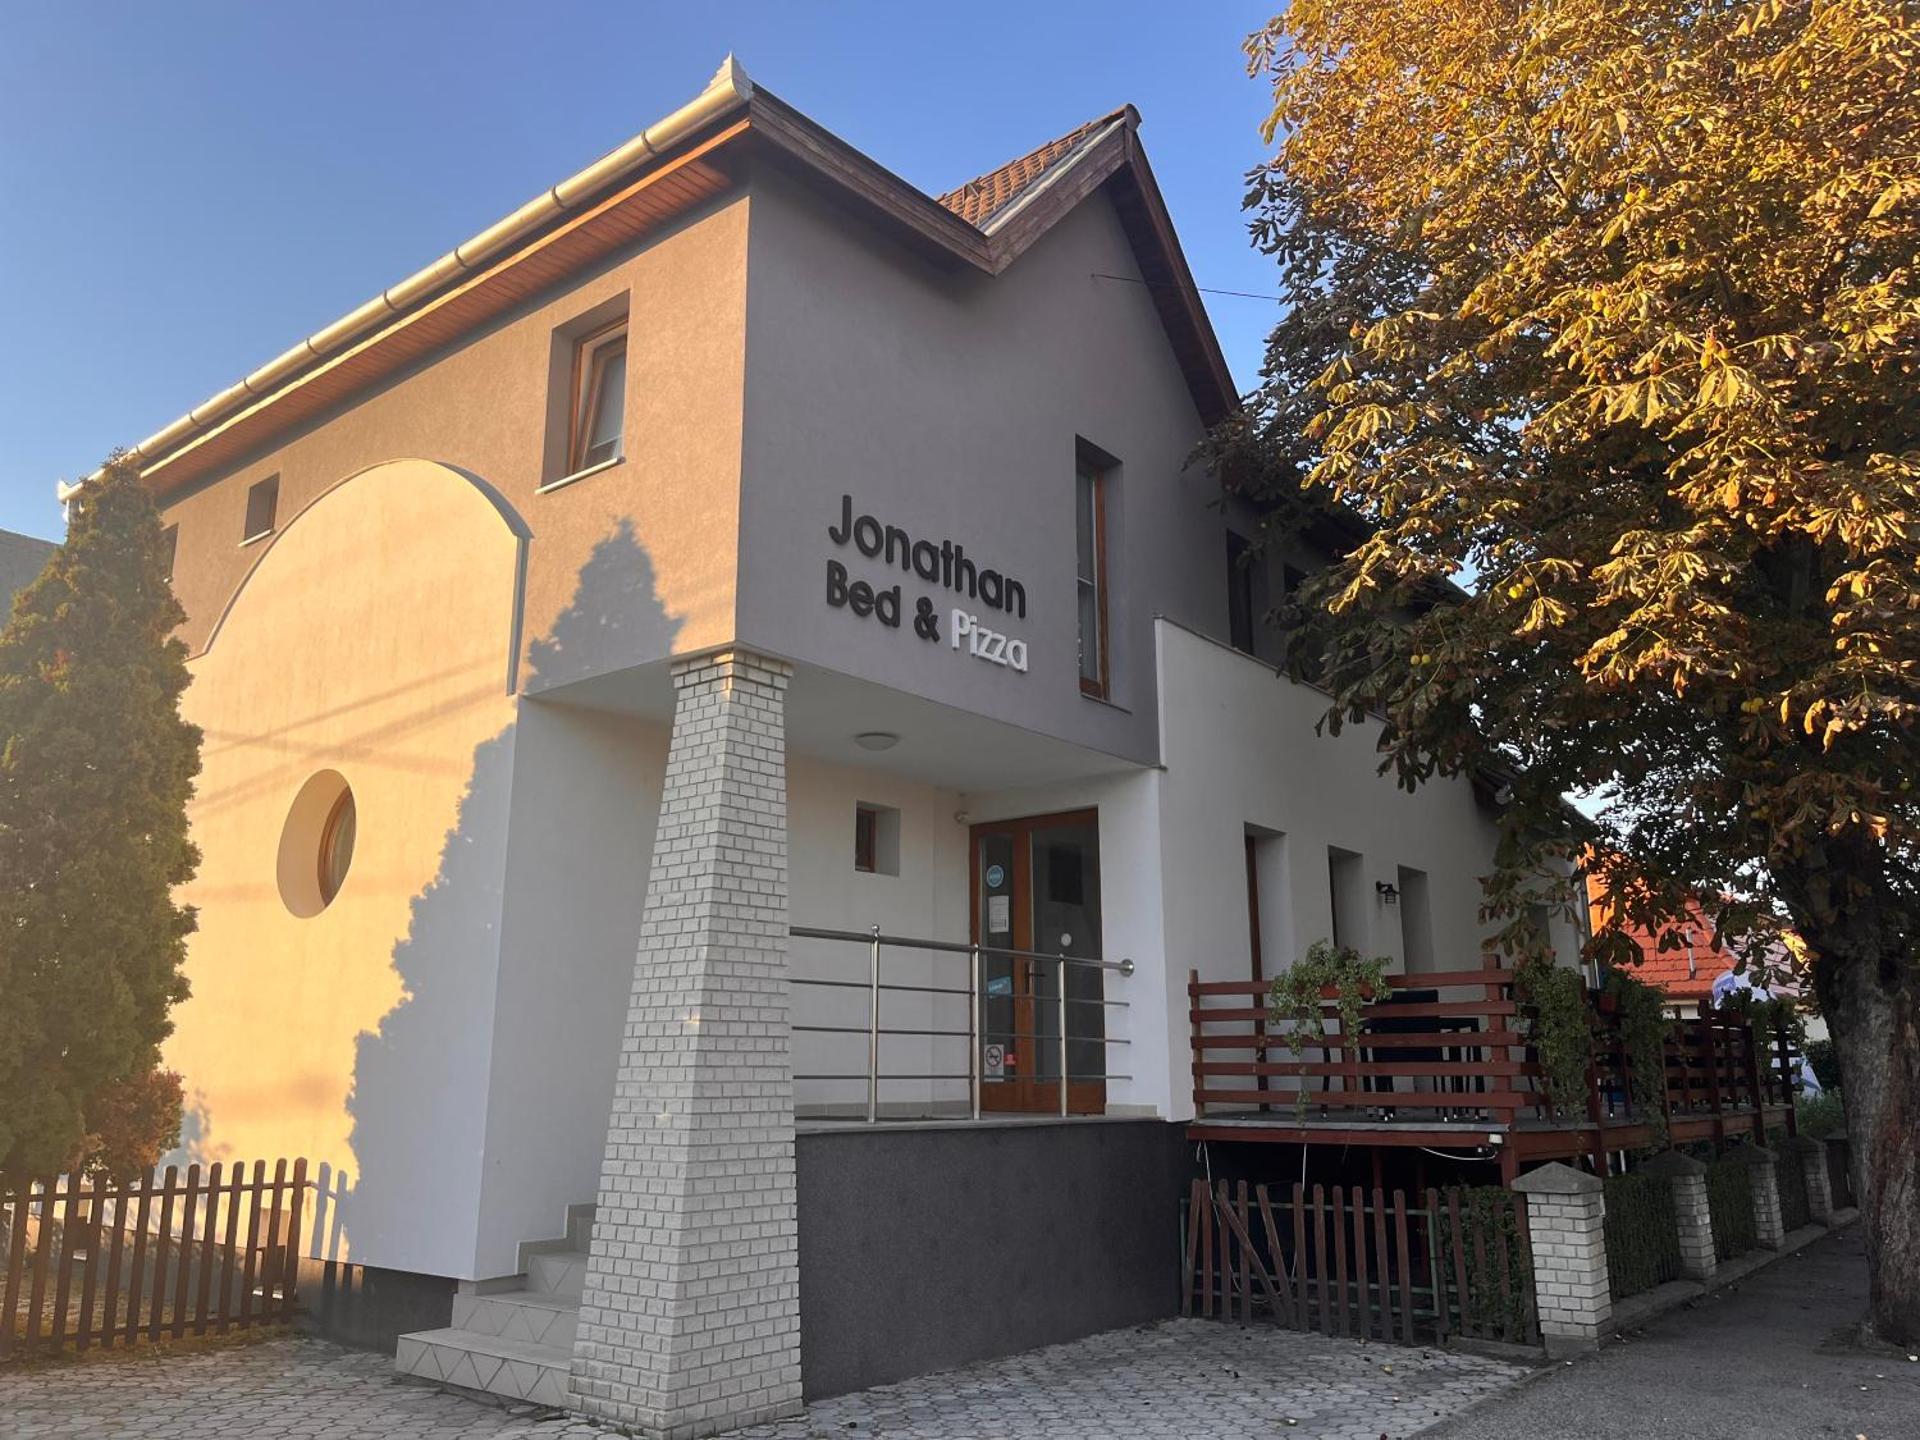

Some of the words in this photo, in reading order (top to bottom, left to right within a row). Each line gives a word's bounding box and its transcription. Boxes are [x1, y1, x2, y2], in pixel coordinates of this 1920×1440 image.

[827, 559, 901, 628] Bed
[913, 596, 940, 643] &
[952, 608, 1028, 673] Pizza
[828, 494, 1026, 619] Jonathan
